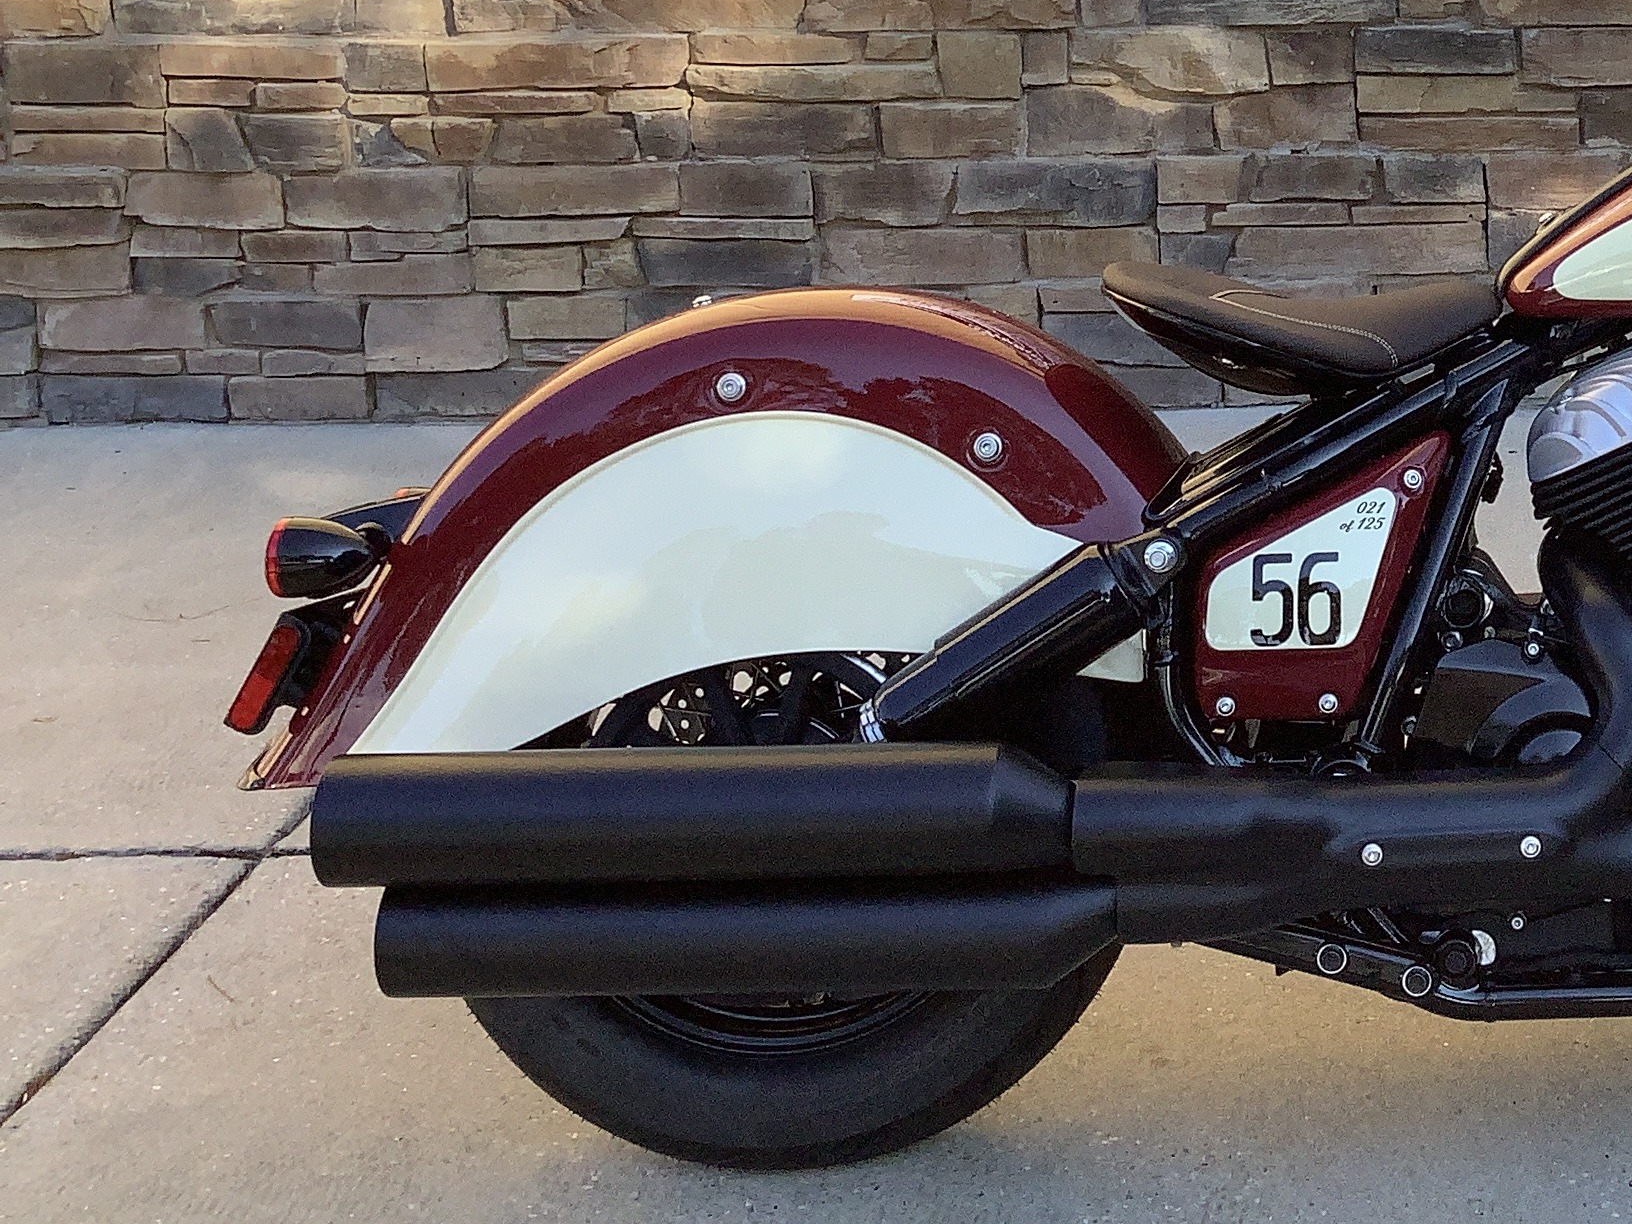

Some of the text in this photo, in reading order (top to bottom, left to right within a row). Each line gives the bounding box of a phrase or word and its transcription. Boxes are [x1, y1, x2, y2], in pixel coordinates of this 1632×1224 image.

[1356, 501, 1386, 514] 021
[1339, 516, 1386, 533] of 125
[1250, 551, 1342, 647] 56
